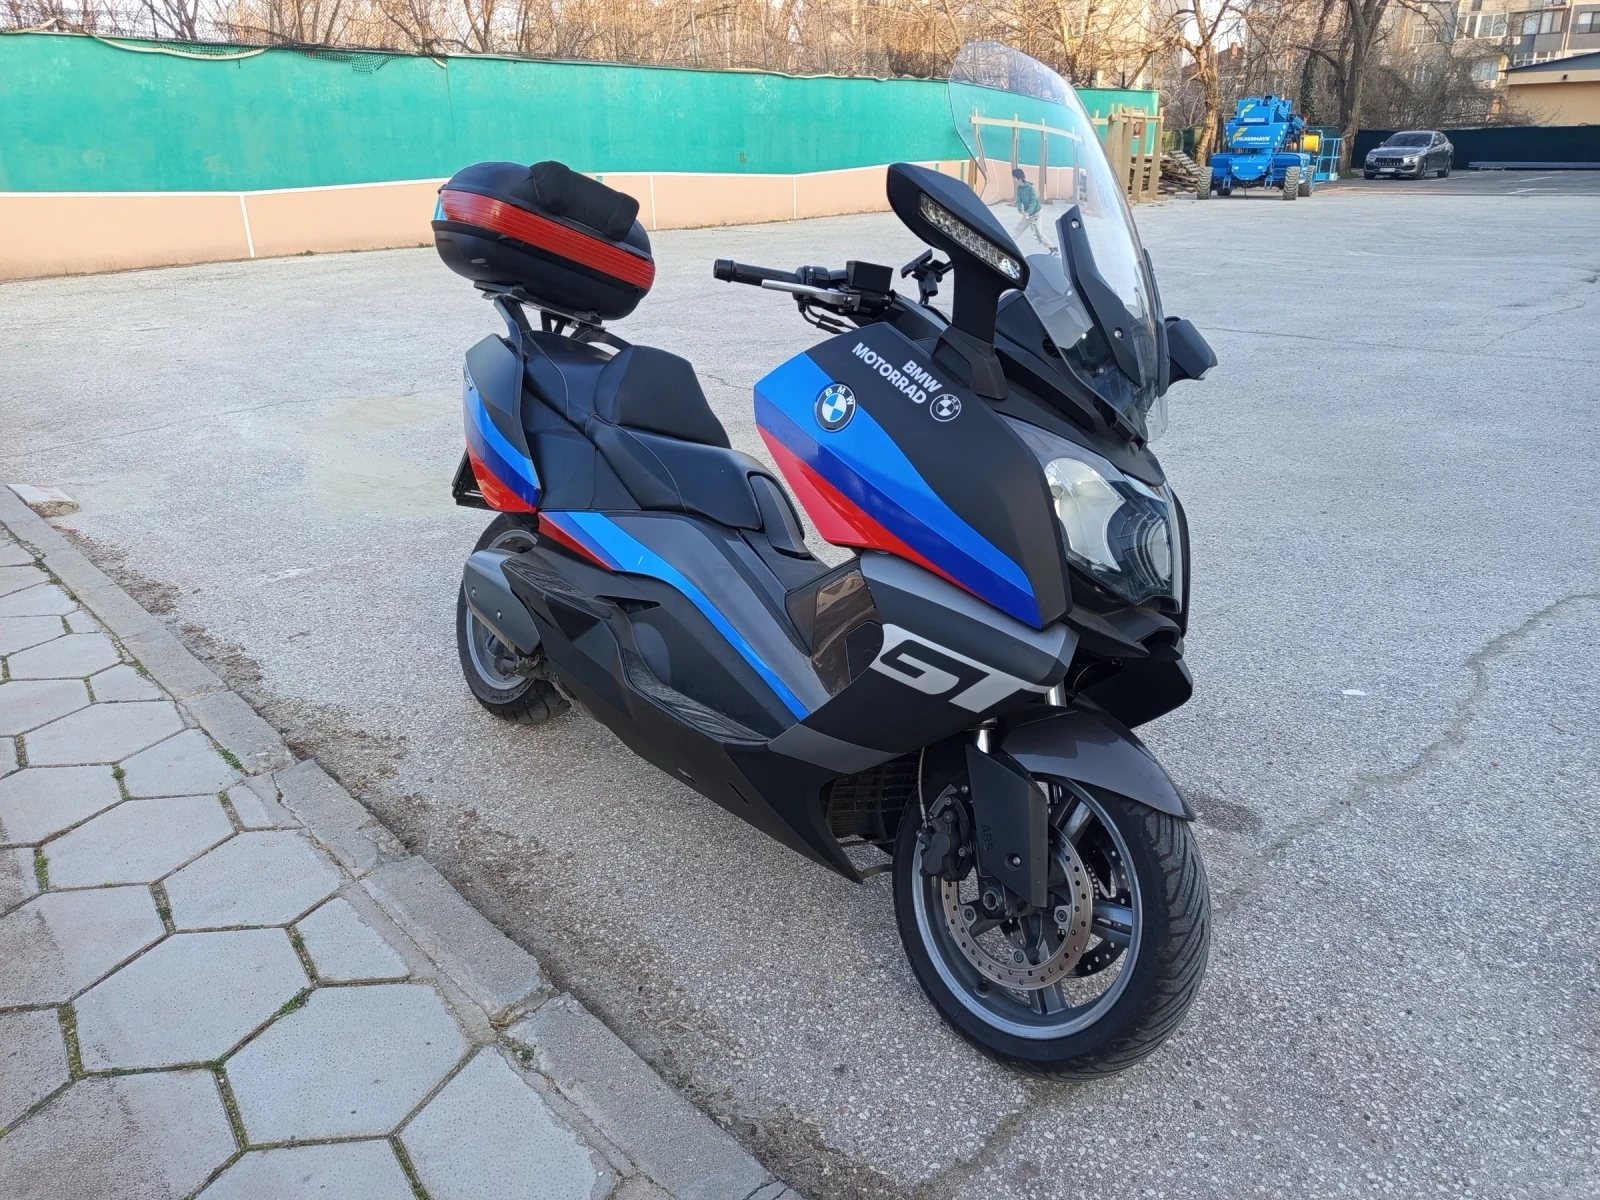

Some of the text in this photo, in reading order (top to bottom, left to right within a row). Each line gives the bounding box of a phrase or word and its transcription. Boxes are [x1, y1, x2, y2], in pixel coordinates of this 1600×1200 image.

[852, 342, 927, 404] MOTORRAD
[902, 360, 943, 393] BMW
[869, 623, 1052, 713] GT
[980, 824, 994, 851] ABS
